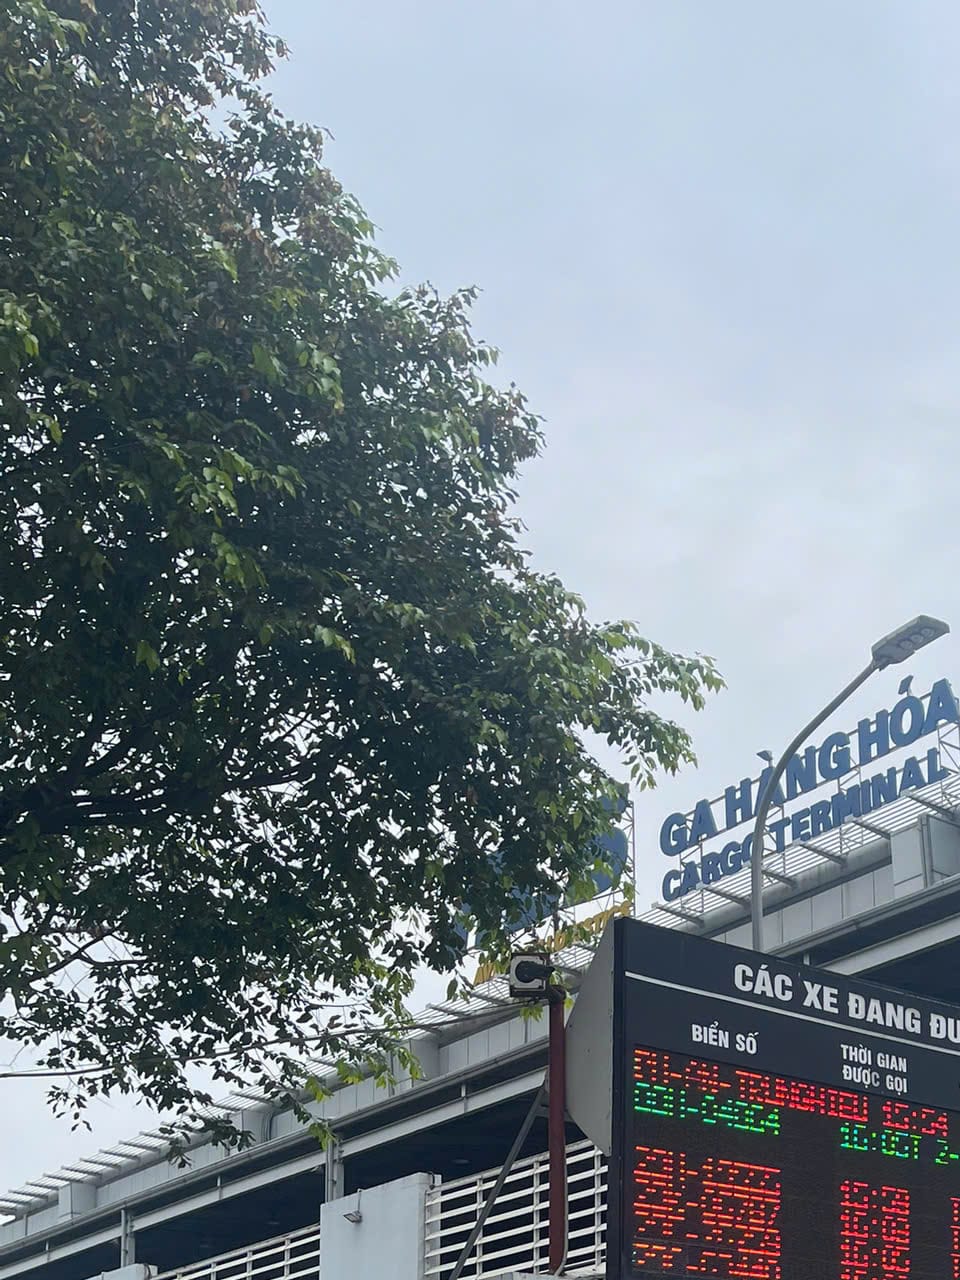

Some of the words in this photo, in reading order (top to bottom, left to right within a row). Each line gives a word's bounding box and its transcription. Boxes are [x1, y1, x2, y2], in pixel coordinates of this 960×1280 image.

[660, 798, 718, 857] GA
[724, 731, 851, 830] HÀNG
[662, 832, 757, 901] CARGO
[769, 747, 949, 853] TERMINAL
[734, 963, 793, 1001] CÁC
[803, 980, 839, 1014] XE
[848, 992, 921, 1034] ĐANG
[691, 1021, 730, 1049] BIỂN
[735, 1032, 759, 1055] SỐ
[840, 1043, 872, 1066] THỜI
[876, 1052, 907, 1073] GIAN
[842, 1064, 880, 1089] ĐƯỢC
[885, 1074, 908, 1096] GỌI
